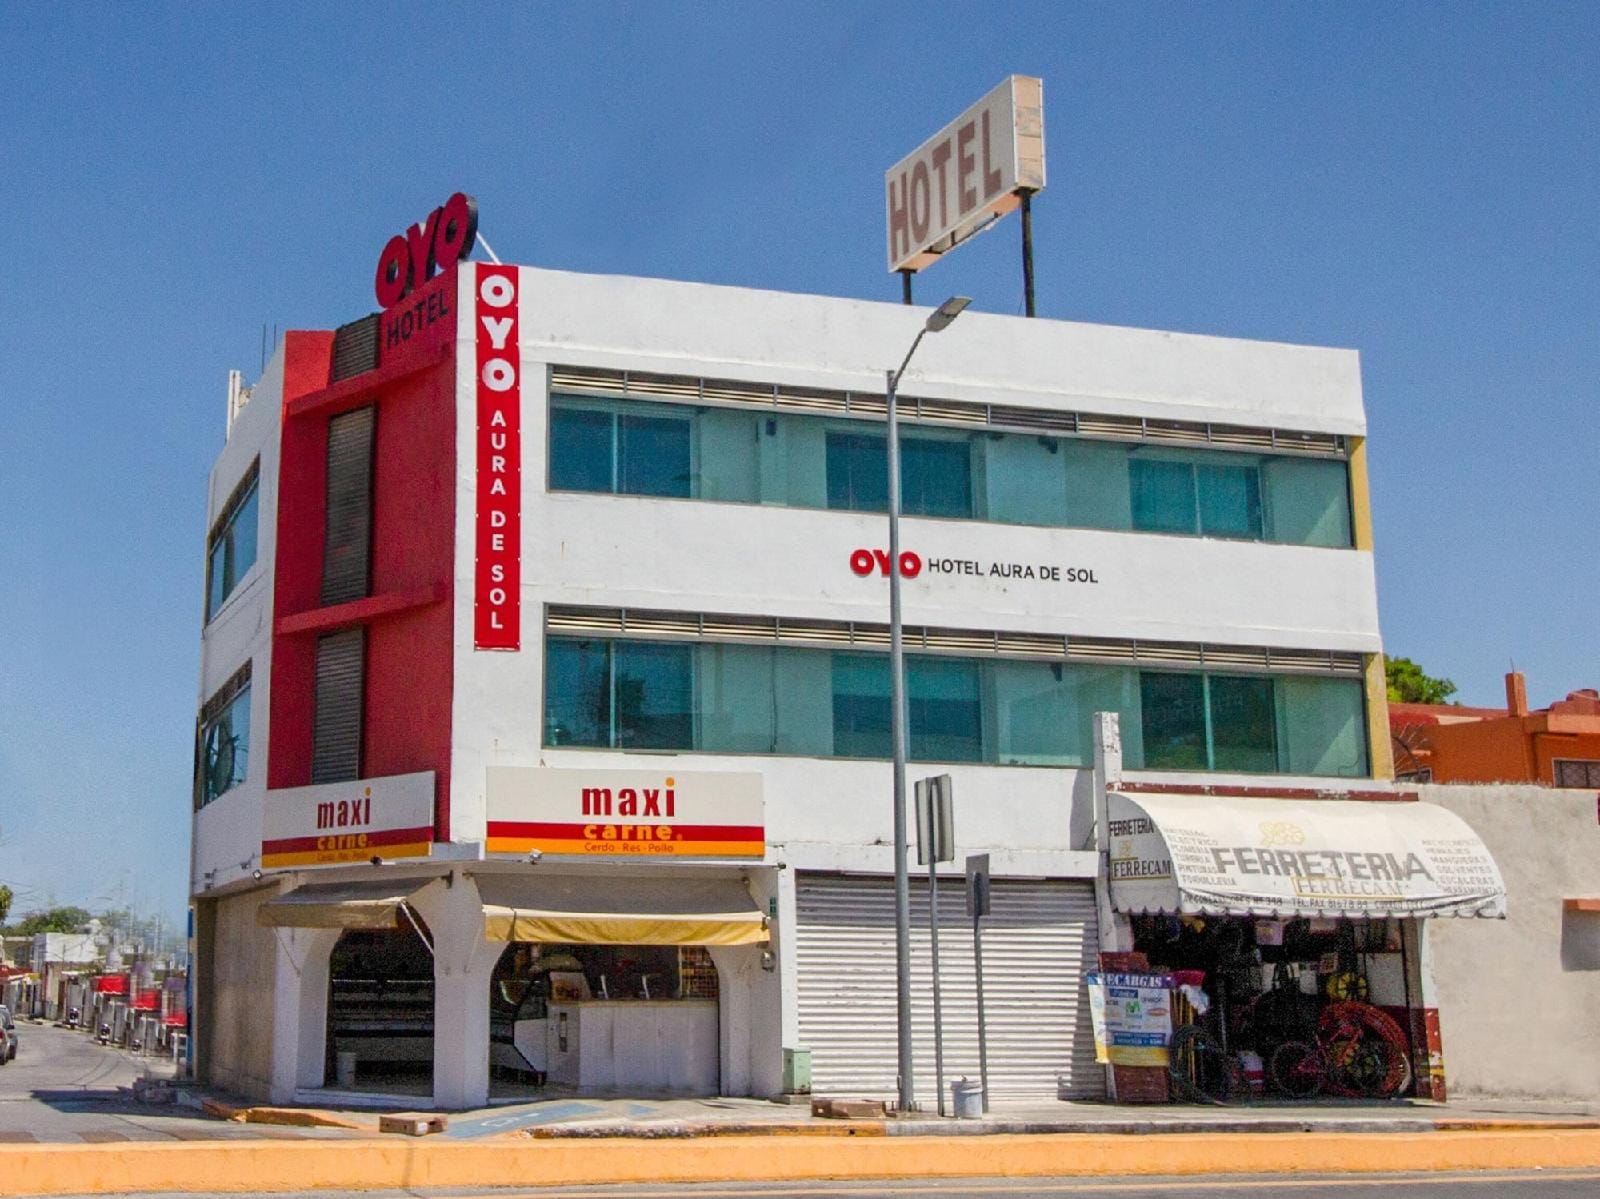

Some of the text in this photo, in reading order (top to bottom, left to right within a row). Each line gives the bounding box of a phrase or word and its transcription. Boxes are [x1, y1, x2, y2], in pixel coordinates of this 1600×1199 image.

[888, 108, 1002, 265] HOTEL
[375, 192, 471, 309] OYO
[386, 288, 449, 349] HOTEL
[480, 274, 516, 630] OYO AURA DE SOL
[850, 549, 1099, 584] OYO HOTEL AURA DE SOL
[317, 786, 372, 829] maxi
[582, 776, 676, 818] maxi
[584, 842, 674, 853] Cerdo Res Pollo
[1108, 818, 1155, 837] FERRETERIA
[1113, 860, 1171, 877] FERRECAM
[1211, 847, 1435, 882] FERRETERIA
